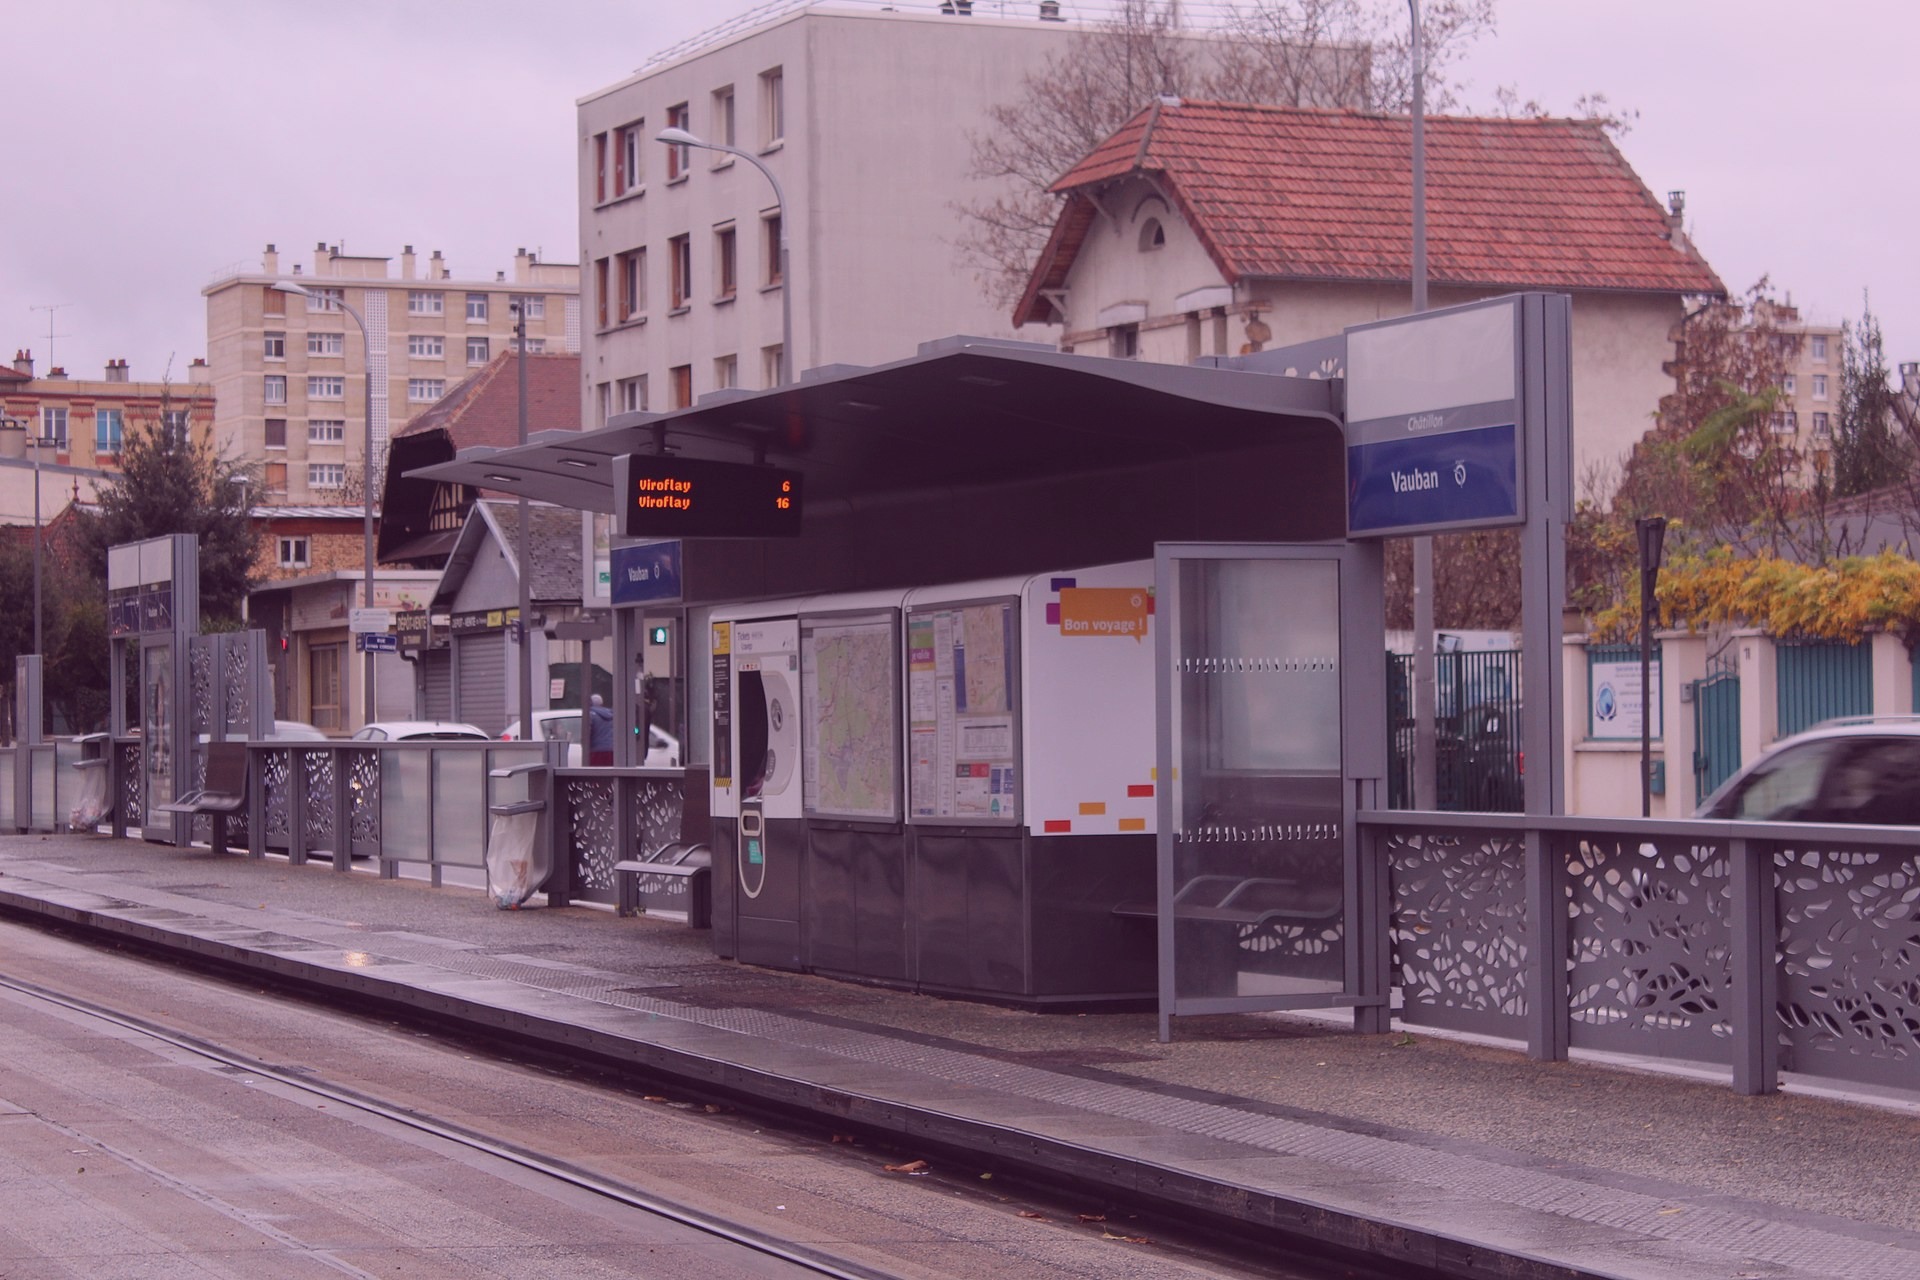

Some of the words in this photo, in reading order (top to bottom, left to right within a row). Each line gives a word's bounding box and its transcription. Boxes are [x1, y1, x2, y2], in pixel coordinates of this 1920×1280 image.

[1407, 415, 1444, 432] Châtillon
[639, 478, 691, 493] Viroflay
[782, 480, 791, 492] 6
[1391, 467, 1439, 493] Vauban
[638, 495, 691, 510] Viroflay
[776, 497, 790, 509] 16
[628, 566, 649, 583] Vauban
[1064, 618, 1089, 631] Bon
[1092, 620, 1135, 633] voyage
[1138, 617, 1143, 630] !
[1743, 647, 1751, 660] 11
